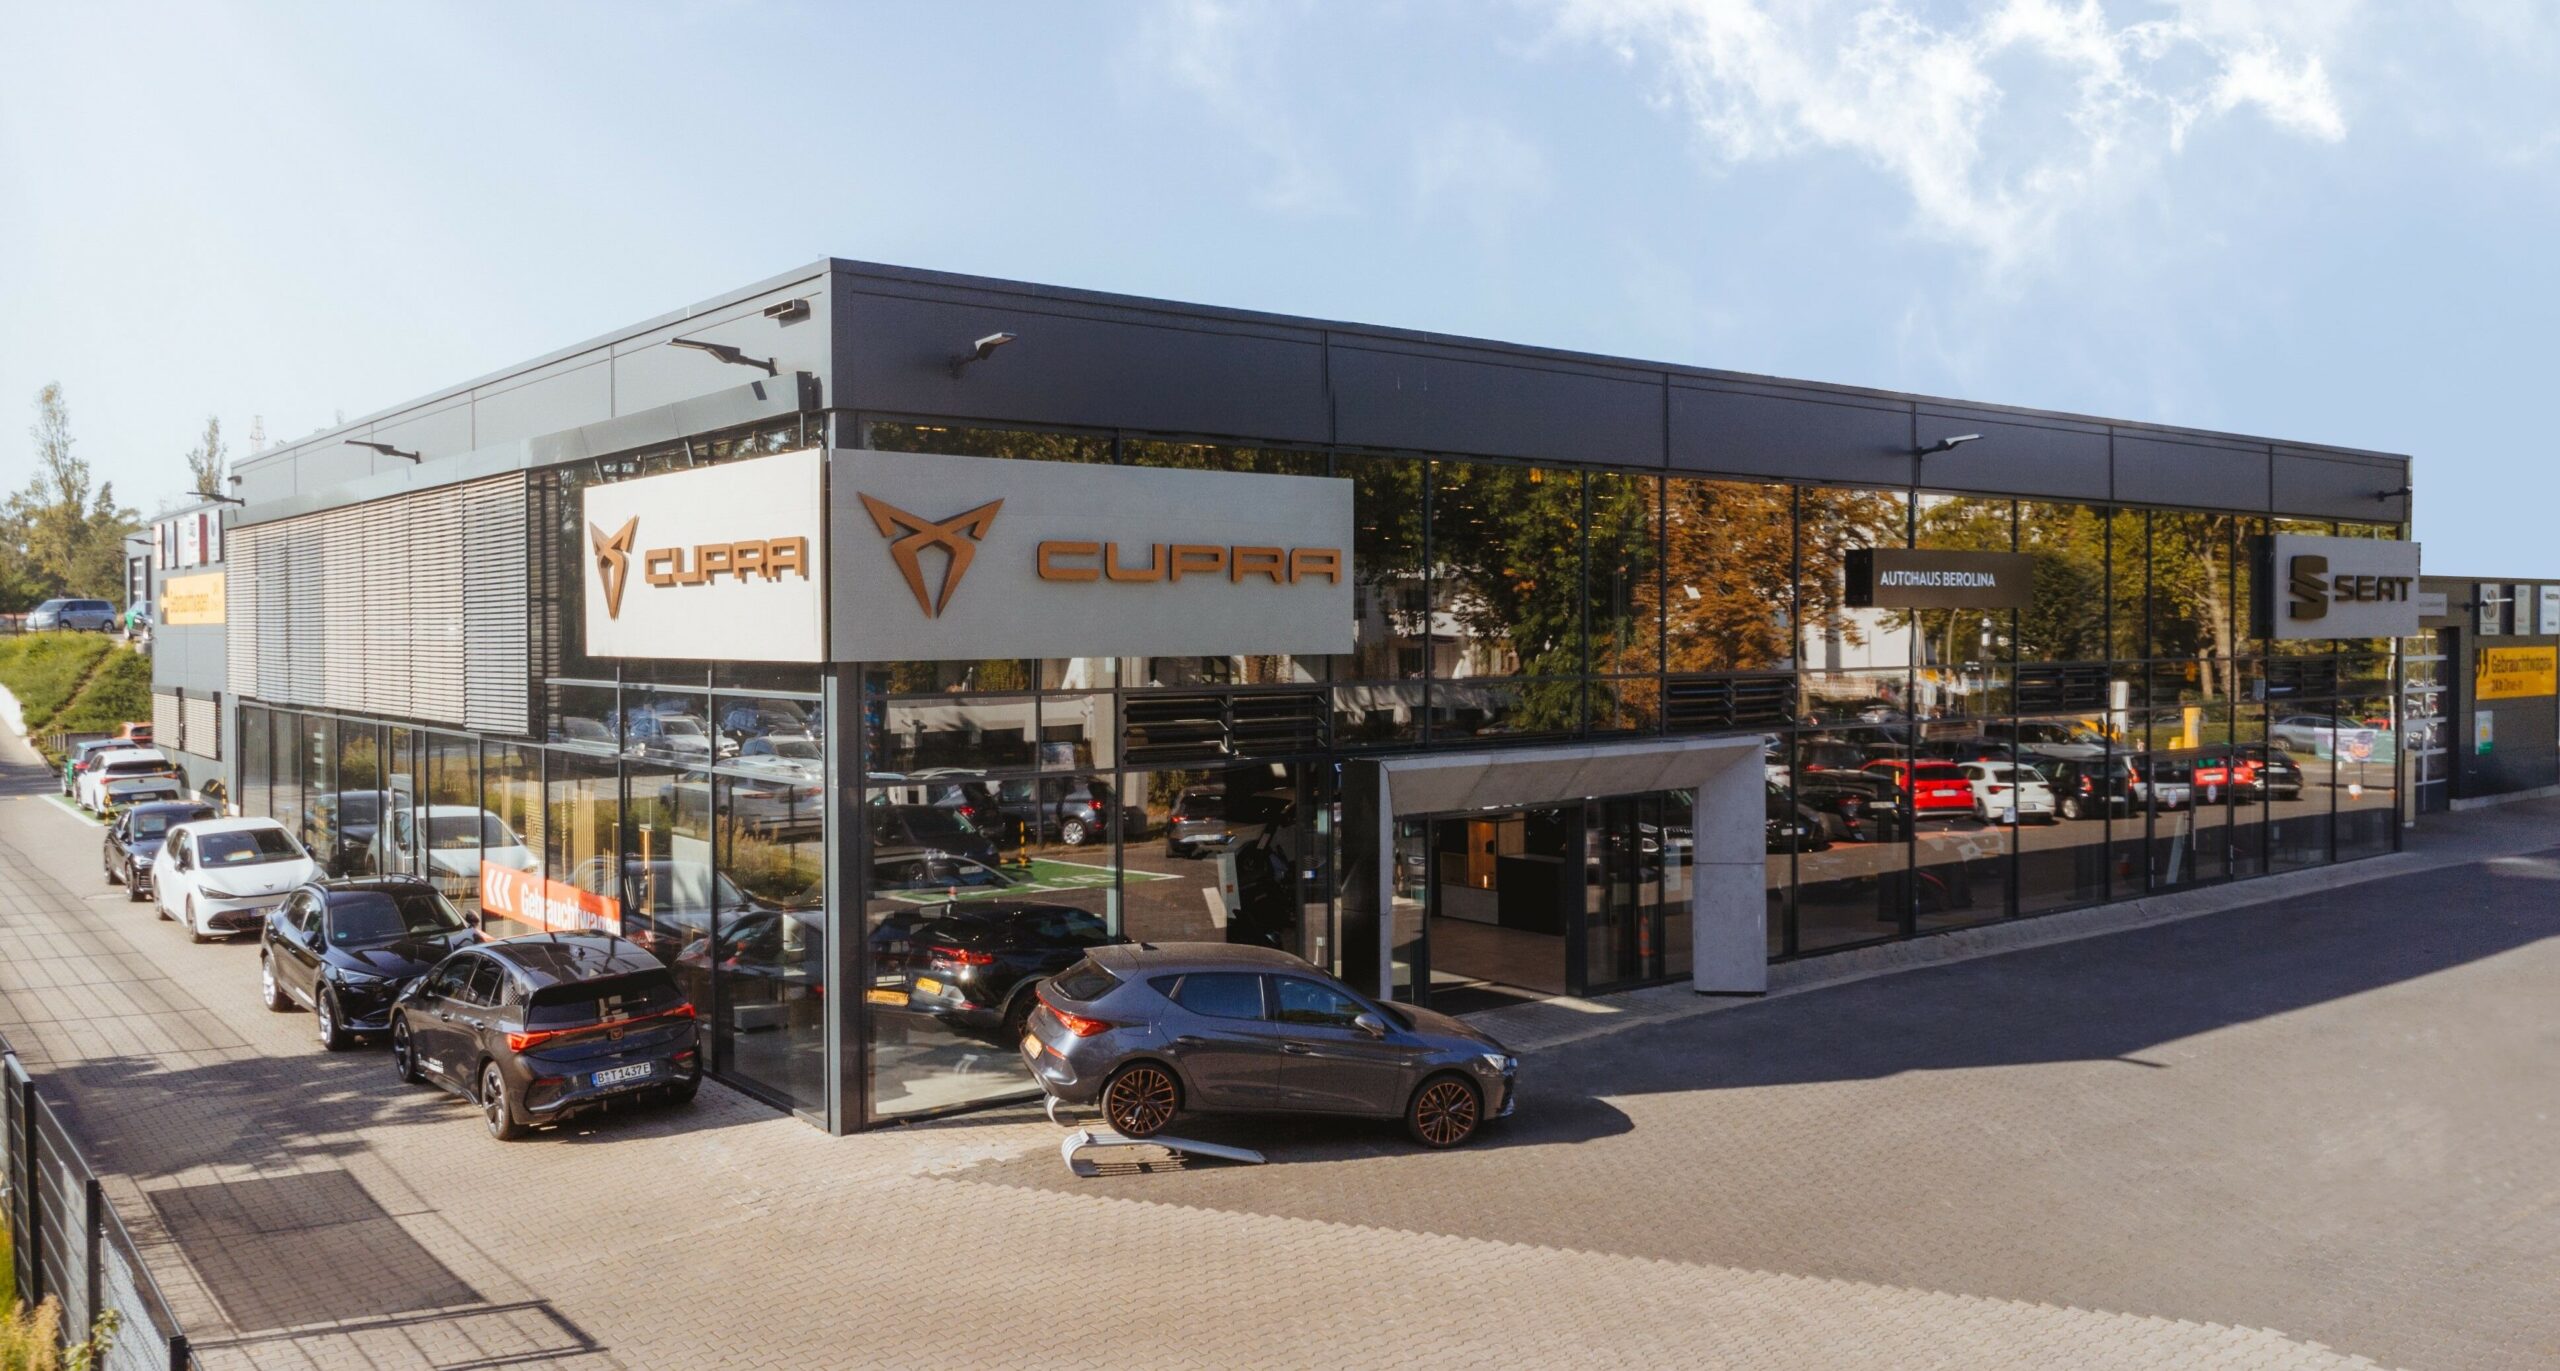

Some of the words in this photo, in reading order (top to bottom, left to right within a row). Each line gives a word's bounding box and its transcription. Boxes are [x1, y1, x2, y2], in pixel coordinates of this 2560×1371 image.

[645, 536, 809, 588] CUPRA
[1037, 540, 1342, 584] CUPRA
[1880, 570, 1941, 586] AUTOHAUS
[1942, 571, 1996, 587] BEROLINA
[2334, 574, 2414, 602] SEAT
